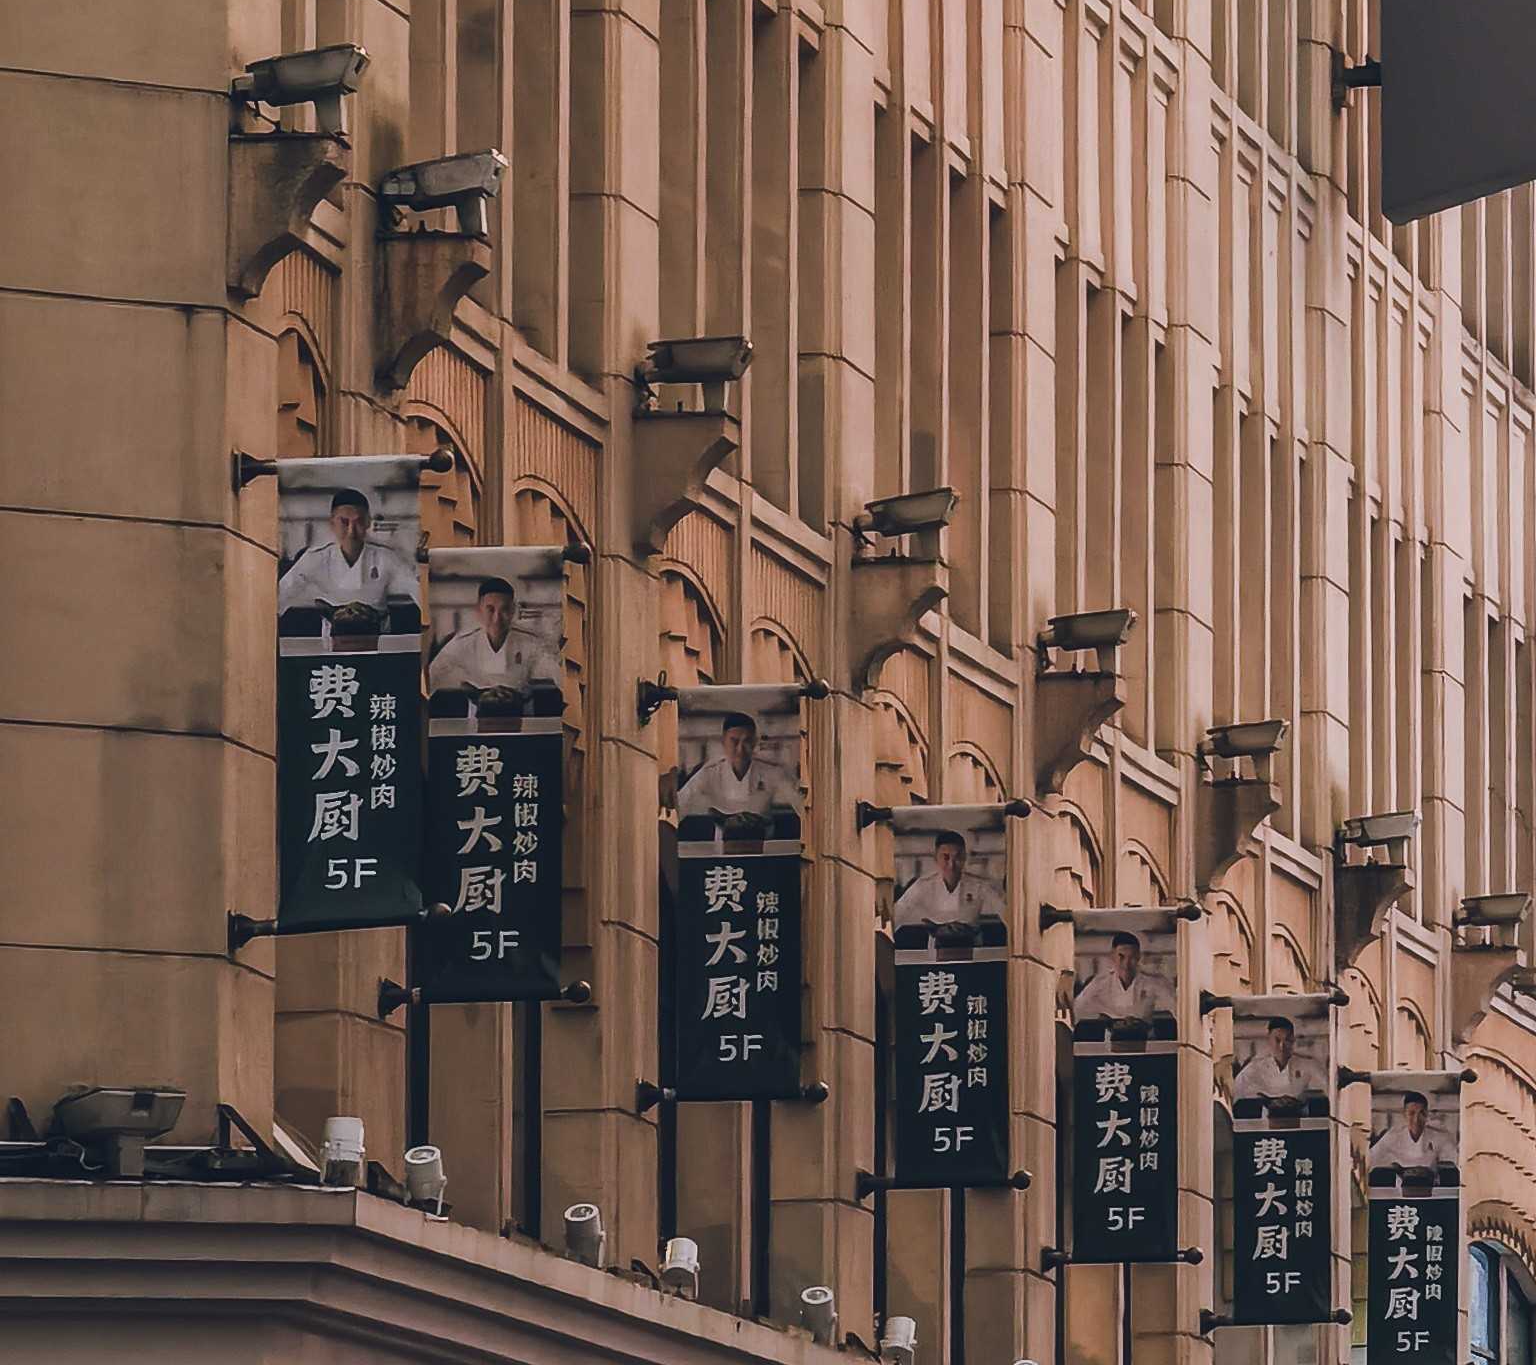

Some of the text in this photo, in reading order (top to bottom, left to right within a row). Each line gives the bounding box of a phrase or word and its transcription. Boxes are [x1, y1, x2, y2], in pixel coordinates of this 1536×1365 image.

[308, 664, 363, 842] 费大厨
[370, 694, 396, 809] 辣椒炒肉
[325, 859, 377, 889] 5F
[454, 745, 506, 913] 费大厨
[513, 774, 538, 883] 辣椒炒肉
[472, 931, 519, 960] 5F
[702, 866, 749, 1019] 费大厨
[720, 1035, 762, 1061] 5F
[919, 972, 962, 1112] 费大厨
[935, 1127, 973, 1151] 5F
[1094, 1063, 1134, 1193] 费大厨
[1108, 1208, 1144, 1230] 5F
[1253, 1138, 1289, 1260] 费大厨
[1267, 1272, 1300, 1293] 5F
[1385, 1205, 1420, 1320] 费大厨
[1397, 1331, 1429, 1351] 5F
